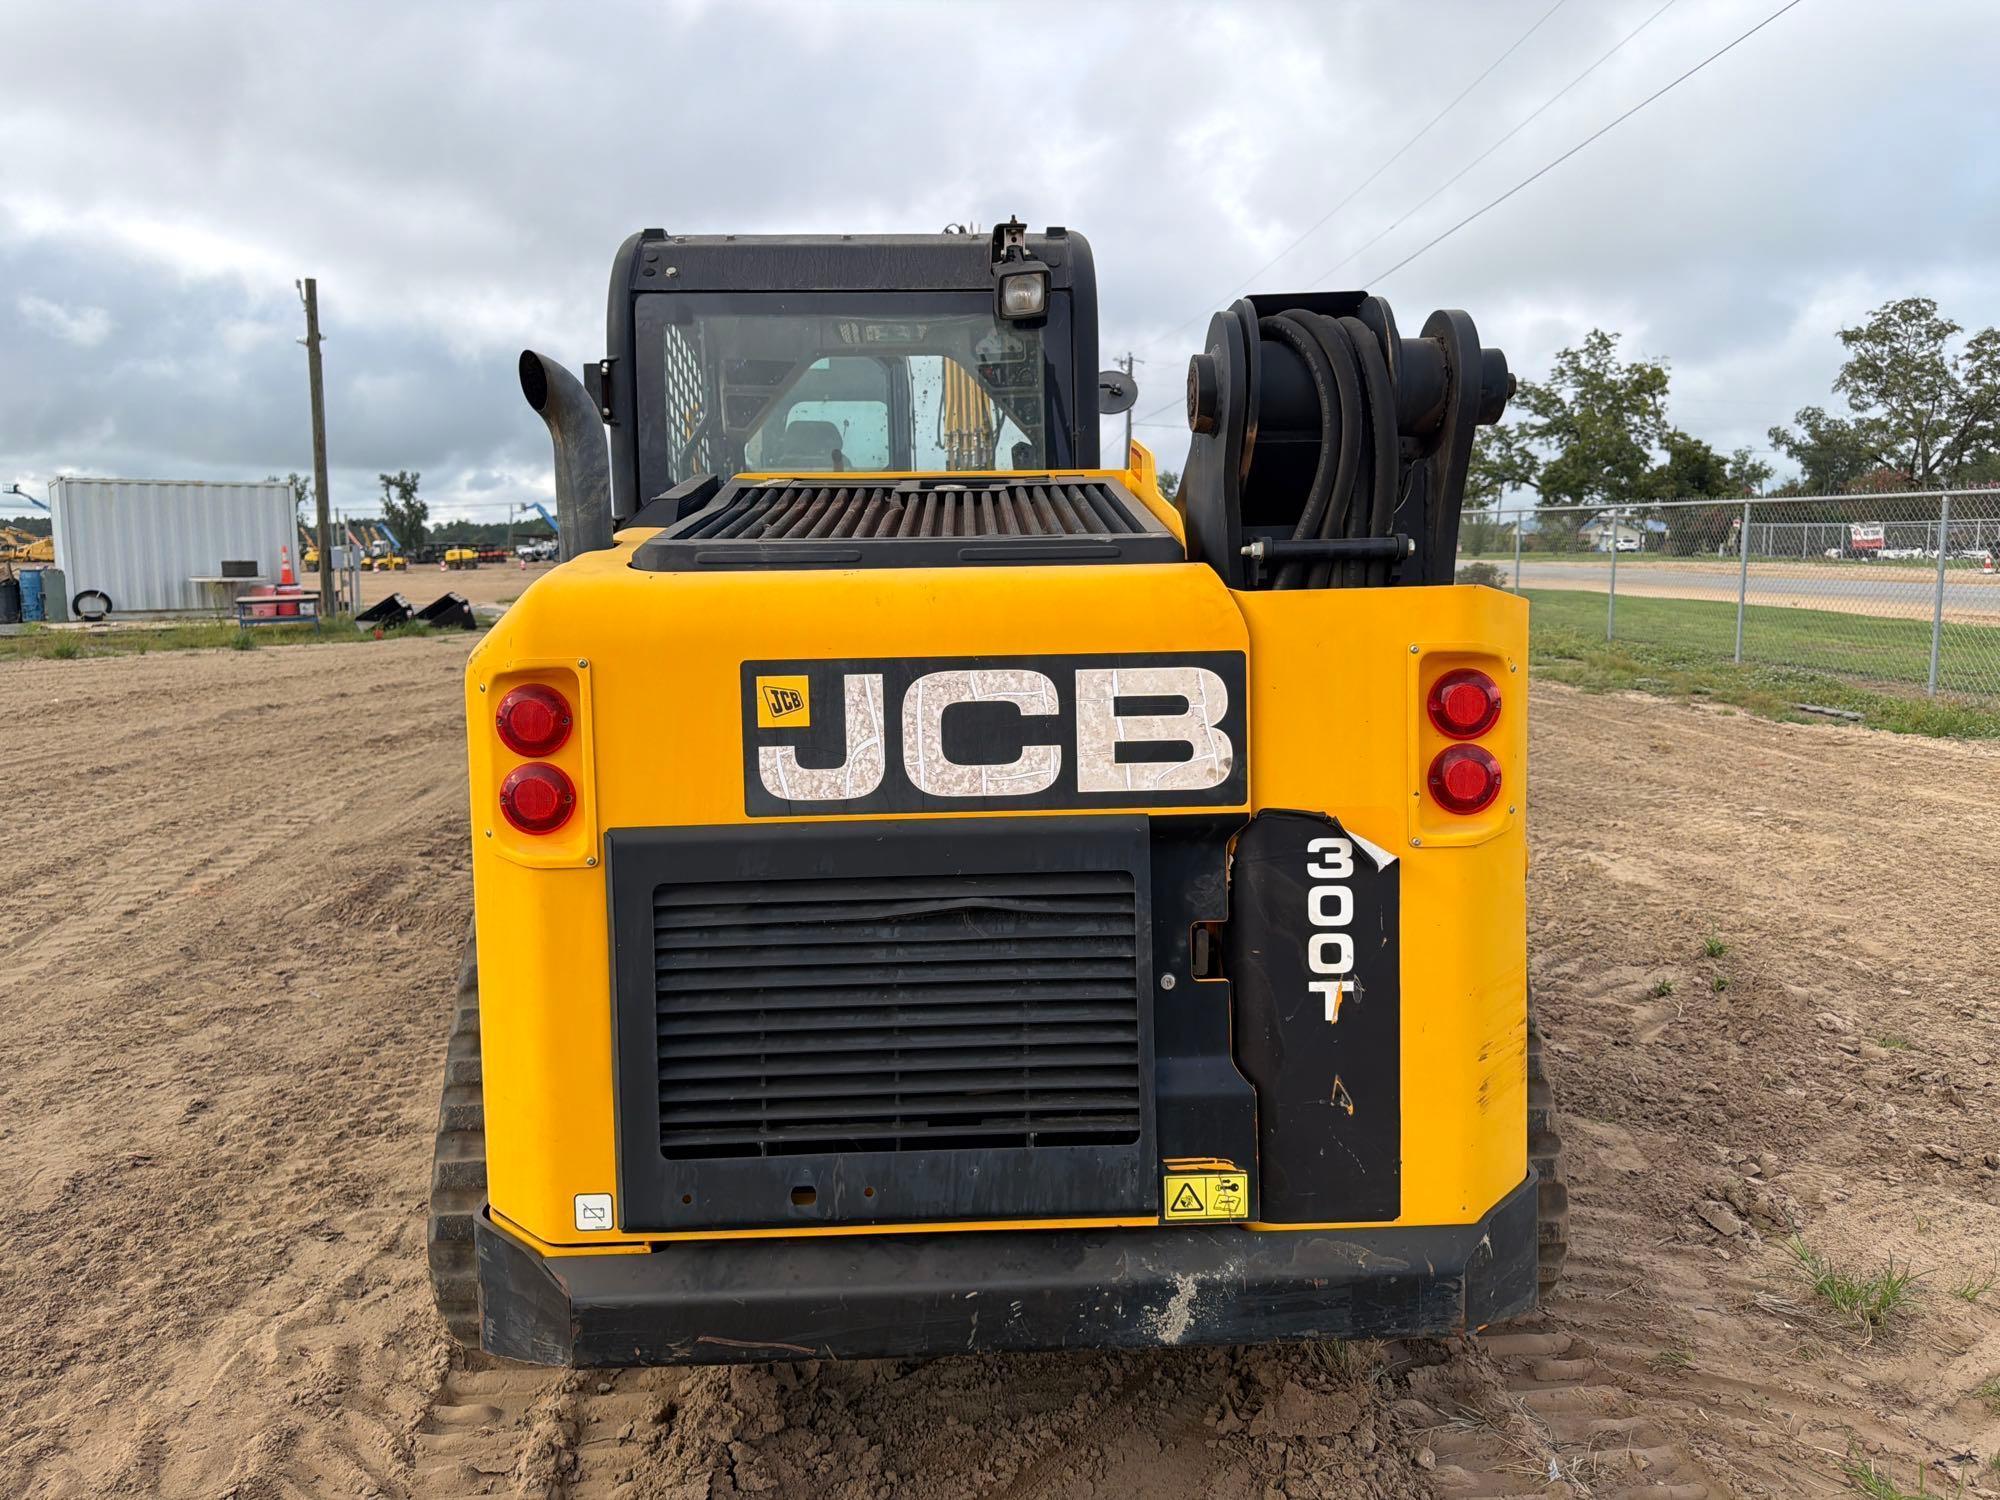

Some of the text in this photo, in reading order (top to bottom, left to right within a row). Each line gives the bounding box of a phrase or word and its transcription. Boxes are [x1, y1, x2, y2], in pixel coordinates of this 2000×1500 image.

[758, 666, 1234, 801] JCB
[769, 689, 802, 714] JCB
[1306, 837, 1355, 1022] 300T
